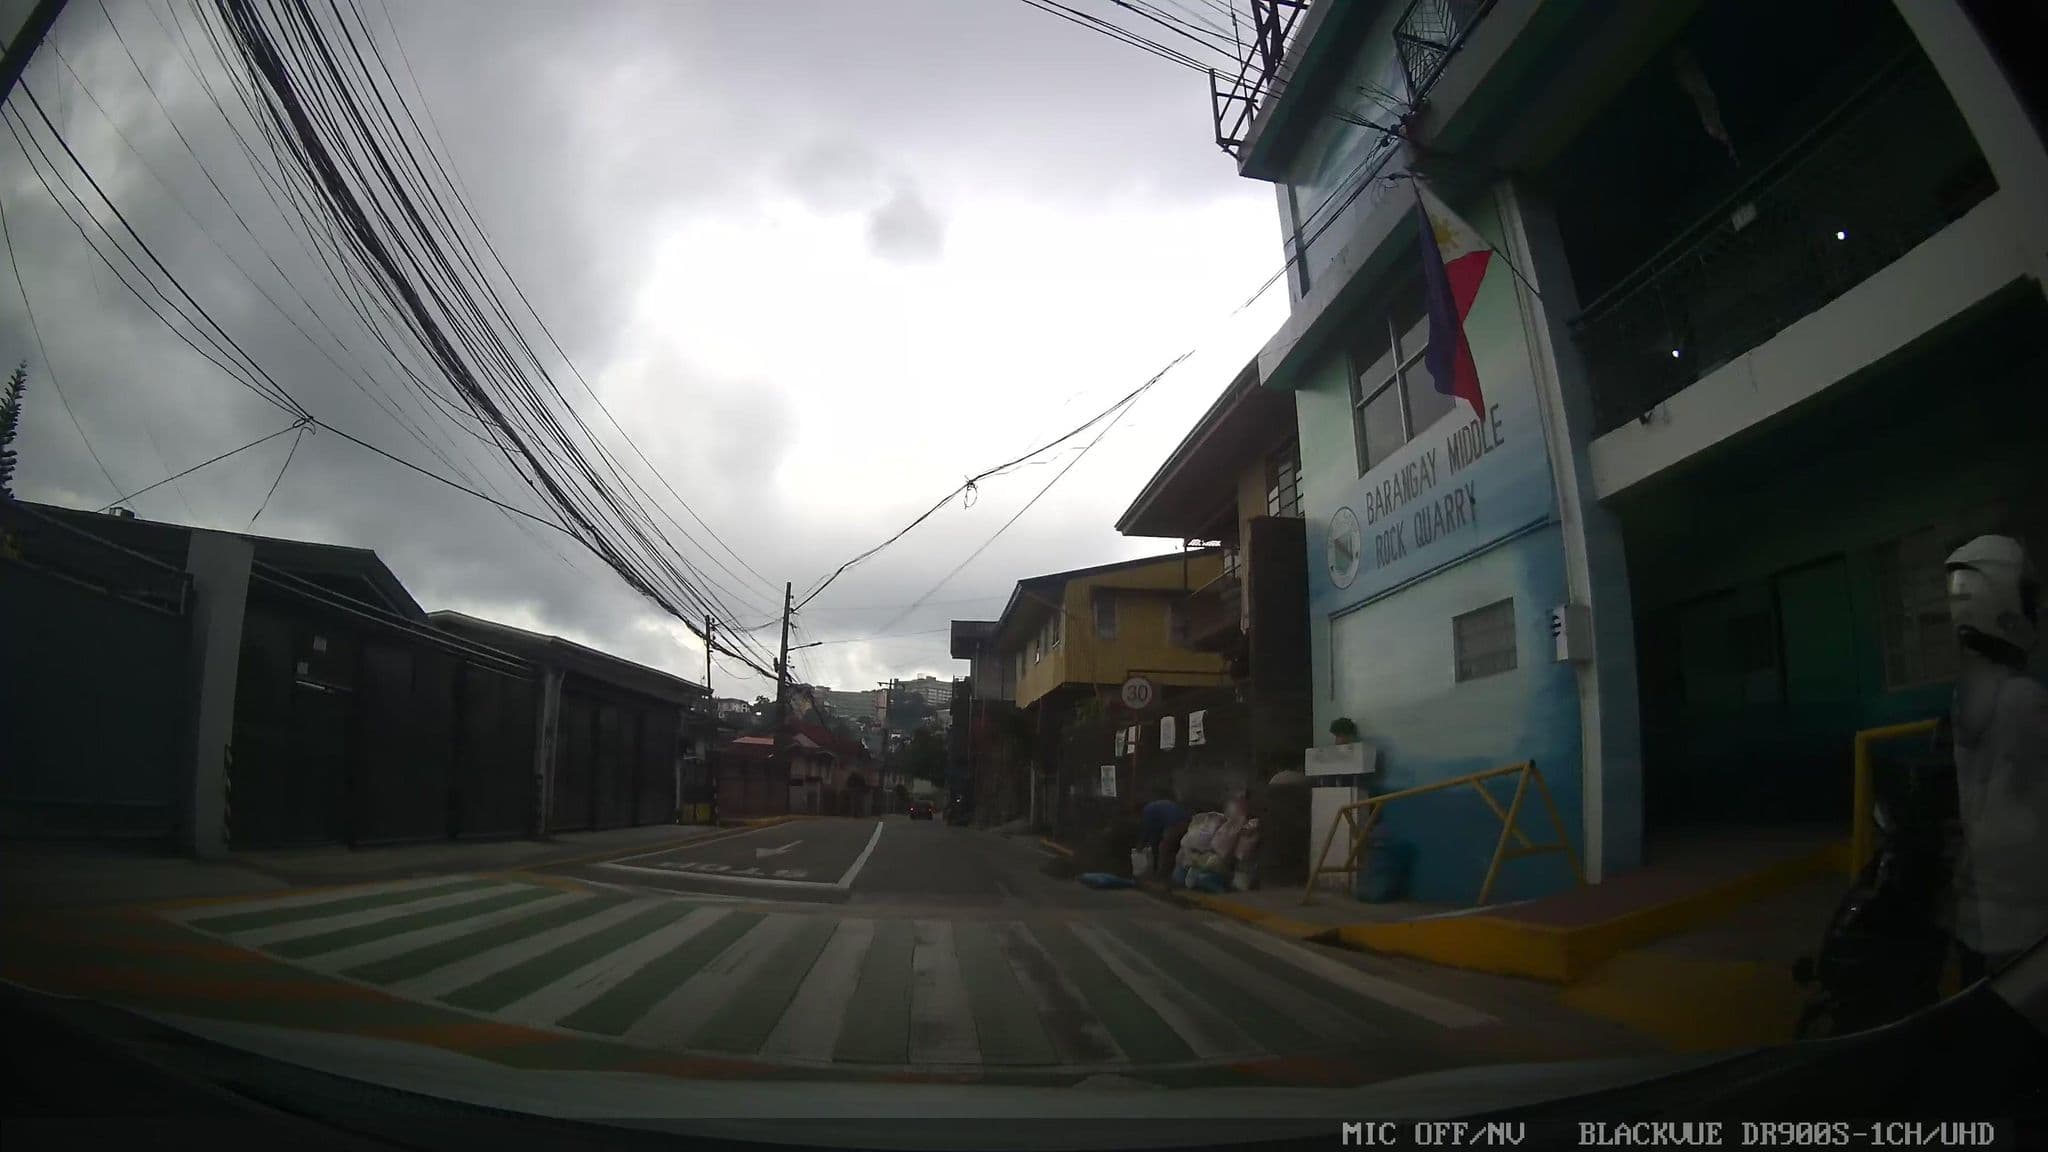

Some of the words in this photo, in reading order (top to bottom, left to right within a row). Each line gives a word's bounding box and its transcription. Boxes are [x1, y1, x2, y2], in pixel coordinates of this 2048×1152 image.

[1366, 448, 1437, 525] BARANGAY
[1447, 403, 1504, 475] MIDDLE
[1375, 520, 1407, 569] ROCK
[1414, 480, 1476, 548] QUARRY
[1127, 685, 1148, 702] 30
